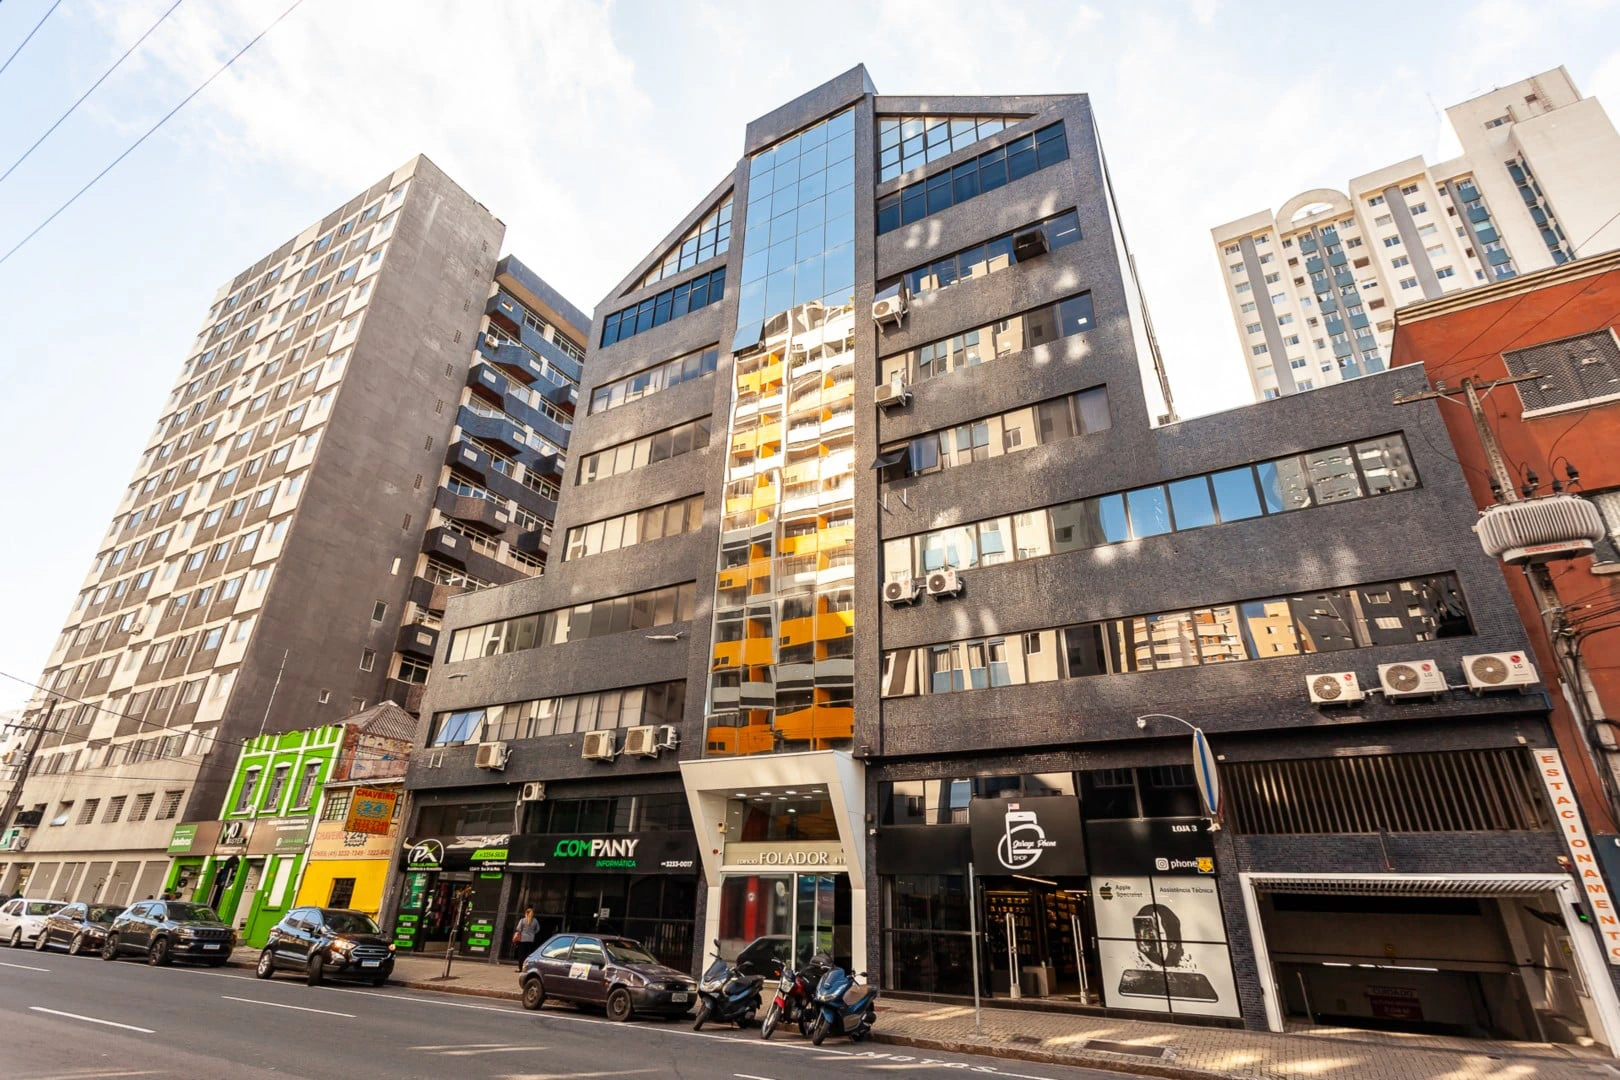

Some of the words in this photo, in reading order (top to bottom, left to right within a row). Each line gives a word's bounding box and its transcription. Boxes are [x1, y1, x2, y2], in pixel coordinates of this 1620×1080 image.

[355, 789, 396, 800] CHAVEIRO
[363, 801, 382, 812] 24
[1037, 839, 1057, 848] Phone
[759, 851, 829, 865] FOLADOR
[1541, 755, 1620, 957] ESTACIONAMENTO
[596, 859, 636, 868] INFORMÁTICA
[855, 1051, 998, 1073] MOTOS
